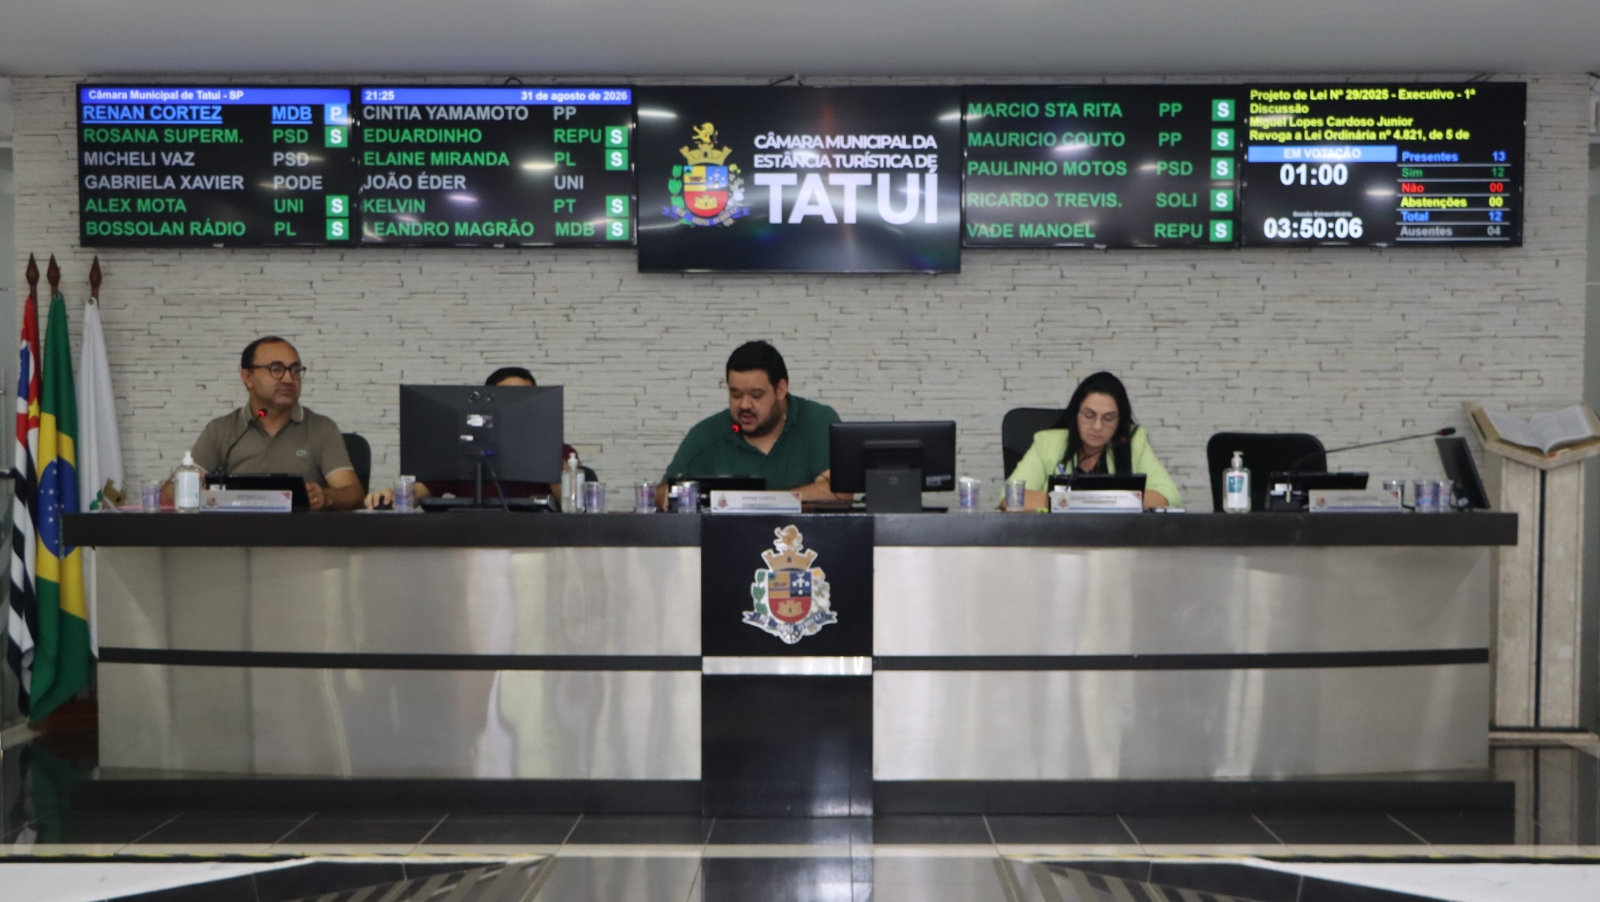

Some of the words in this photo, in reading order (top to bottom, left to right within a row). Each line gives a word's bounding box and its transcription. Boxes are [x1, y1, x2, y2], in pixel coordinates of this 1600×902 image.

[89, 90, 127, 100] Câmara
[130, 90, 178, 101] Municipal
[181, 90, 194, 100] de
[229, 90, 244, 100] SP
[365, 91, 394, 101] 21:25
[521, 91, 533, 101] 31
[535, 91, 549, 101] de
[551, 91, 586, 103] agosto
[588, 91, 601, 101] de
[603, 91, 628, 101] 2026
[1250, 89, 1291, 102] Projeto
[1293, 89, 1308, 100] de
[1309, 89, 1327, 100] Lei
[1345, 89, 1389, 100] 29/2025
[1398, 89, 1454, 100] Executivo
[83, 105, 145, 120] RENAN
[150, 105, 222, 120] CORTEZ
[272, 105, 312, 120] MDB
[330, 105, 343, 120] P
[363, 106, 421, 120] CINTIA
[426, 106, 529, 120] YAMAMOTO
[553, 106, 576, 120] PP
[967, 103, 1040, 117] MARCIO
[1044, 103, 1078, 117] STA
[1083, 103, 1123, 117] RITA
[1159, 103, 1182, 117] PP
[1217, 103, 1230, 117] S
[1250, 103, 1309, 114] Discussão
[1249, 116, 1287, 129] Miguel
[1289, 117, 1324, 129] Lopes
[1326, 116, 1375, 127] Cardoso
[1376, 116, 1414, 127] Junior
[83, 129, 159, 143] ROSANA
[164, 129, 244, 143] SUPERM.
[273, 129, 309, 143] PSD
[330, 129, 342, 143] S
[363, 129, 482, 143] EDUARDINHO
[554, 129, 601, 143] REPU
[610, 129, 623, 143] S
[754, 131, 824, 149] CÂMARA
[825, 135, 911, 149] MUNICIPAL
[912, 135, 937, 149] DA
[967, 132, 1056, 147] MAURICIO
[1062, 132, 1125, 147] COUTO
[1158, 132, 1181, 147] PP
[1216, 132, 1229, 147] S
[1249, 129, 1292, 143] Revoga
[1294, 132, 1302, 140] a
[1304, 129, 1322, 140] Lei
[1324, 129, 1377, 140] Ordinária
[1428, 129, 1443, 140] de
[1446, 129, 1453, 140] 5
[1455, 129, 1470, 140] de
[84, 152, 155, 166] MICHELI
[161, 152, 195, 166] VAZ
[273, 152, 309, 166] PSD
[364, 152, 425, 166] ELAINE
[430, 152, 510, 166] MIRANDA
[554, 152, 576, 166] PL
[611, 152, 623, 166] S
[754, 151, 832, 168] ESTÂNCIA
[833, 151, 913, 168] TURÍSTICA
[915, 155, 938, 168] DE
[1284, 148, 1301, 159] EM
[1303, 146, 1362, 160] VOTAÇÃO
[1401, 151, 1459, 162] Presentes
[1492, 151, 1506, 162] 13
[967, 161, 1058, 176] PAULINHO
[1063, 161, 1127, 176] MOTOS
[1156, 161, 1193, 176] PSD
[1216, 161, 1228, 176] S
[1280, 163, 1348, 186] 01:00
[1401, 167, 1424, 178] Sim
[1492, 167, 1505, 178] 12
[84, 175, 176, 190] GABRIELA
[180, 175, 244, 190] XAVIER
[273, 175, 323, 190] PODE
[363, 172, 412, 189] JOÃO
[418, 172, 466, 189] ÉDER
[554, 175, 584, 189] UNI
[1401, 182, 1425, 193] Não
[1489, 182, 1504, 193] 00
[754, 166, 938, 224] TATUÍ
[966, 193, 1049, 208] RICARDO
[1054, 193, 1122, 208] TREVIS.
[1156, 193, 1197, 208] SOLI
[1215, 193, 1228, 208] S
[85, 198, 132, 213] ALEX
[137, 198, 187, 213] MOTA
[274, 198, 303, 213] UNI
[331, 198, 343, 213] S
[363, 198, 425, 213] KELVIN
[554, 198, 576, 213] PT
[612, 198, 623, 213] S
[1400, 196, 1467, 209] Abstenções
[1489, 196, 1503, 207] 00
[1401, 211, 1430, 222] Total
[1488, 211, 1503, 222] 12
[86, 222, 184, 236] BOSSOLAN
[190, 218, 246, 236] RÁDIO
[274, 222, 296, 236] PL
[332, 222, 343, 236] S
[363, 222, 449, 236] LEANDRO
[455, 218, 534, 236] MAGRÃO
[555, 222, 595, 236] MDB
[612, 222, 623, 236] S
[966, 223, 1014, 238] VADE
[1019, 223, 1095, 238] MANOEL
[1154, 223, 1203, 238] REPU
[1215, 223, 1227, 238] S
[1263, 217, 1363, 239] 03:50:06
[1400, 226, 1453, 236] Ausentes
[1487, 226, 1501, 236] 04
